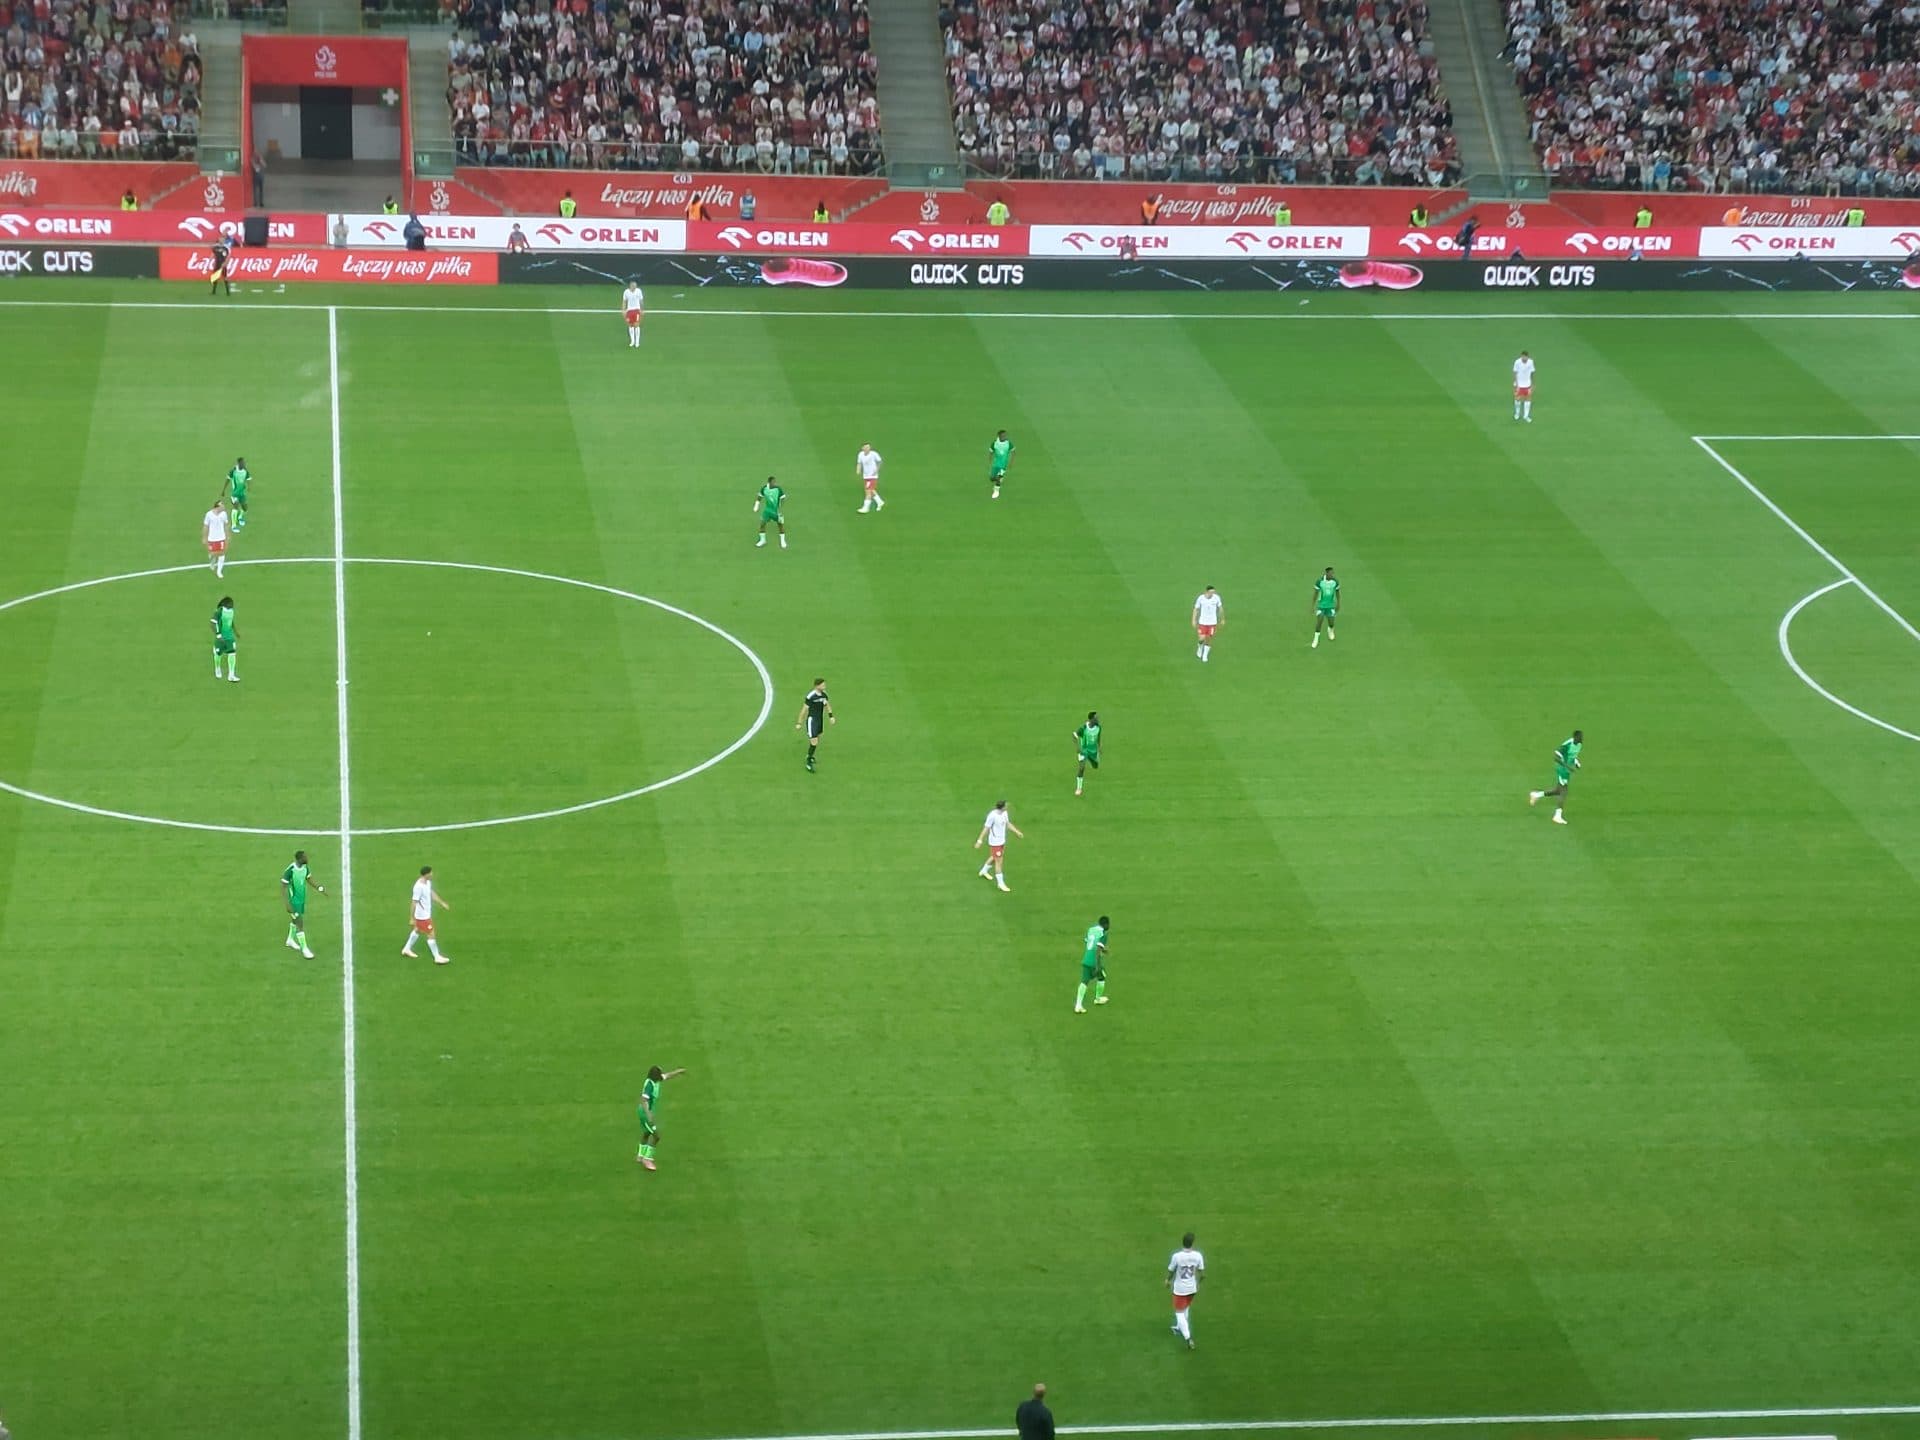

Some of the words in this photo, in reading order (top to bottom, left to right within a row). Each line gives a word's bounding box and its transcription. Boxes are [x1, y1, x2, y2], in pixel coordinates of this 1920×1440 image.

[0, 171, 37, 197] iłka
[600, 183, 655, 208] Łączy
[655, 189, 688, 206] nas
[1204, 201, 1237, 217] nas
[34, 217, 112, 234] ORLEN
[1787, 213, 1822, 227] nas
[219, 221, 295, 238] OEN
[422, 226, 476, 240] RLEN
[580, 227, 659, 243] ORLEN
[756, 230, 829, 247] ORLEN
[928, 233, 1000, 249] ORLEN
[1267, 235, 1343, 250] ORLEN
[1602, 235, 1672, 251] ORLEN
[1768, 236, 1836, 250] ORLEN
[43, 250, 94, 273] CUTS
[240, 257, 273, 273] nas
[272, 253, 319, 278] piłka
[342, 254, 394, 281] Łączy
[394, 259, 427, 277] nas
[425, 255, 472, 281] piłka
[910, 263, 969, 285] QUICK
[978, 264, 1025, 285] CUTS
[1483, 265, 1541, 287] QUICK
[1549, 265, 1596, 287] CUTS
